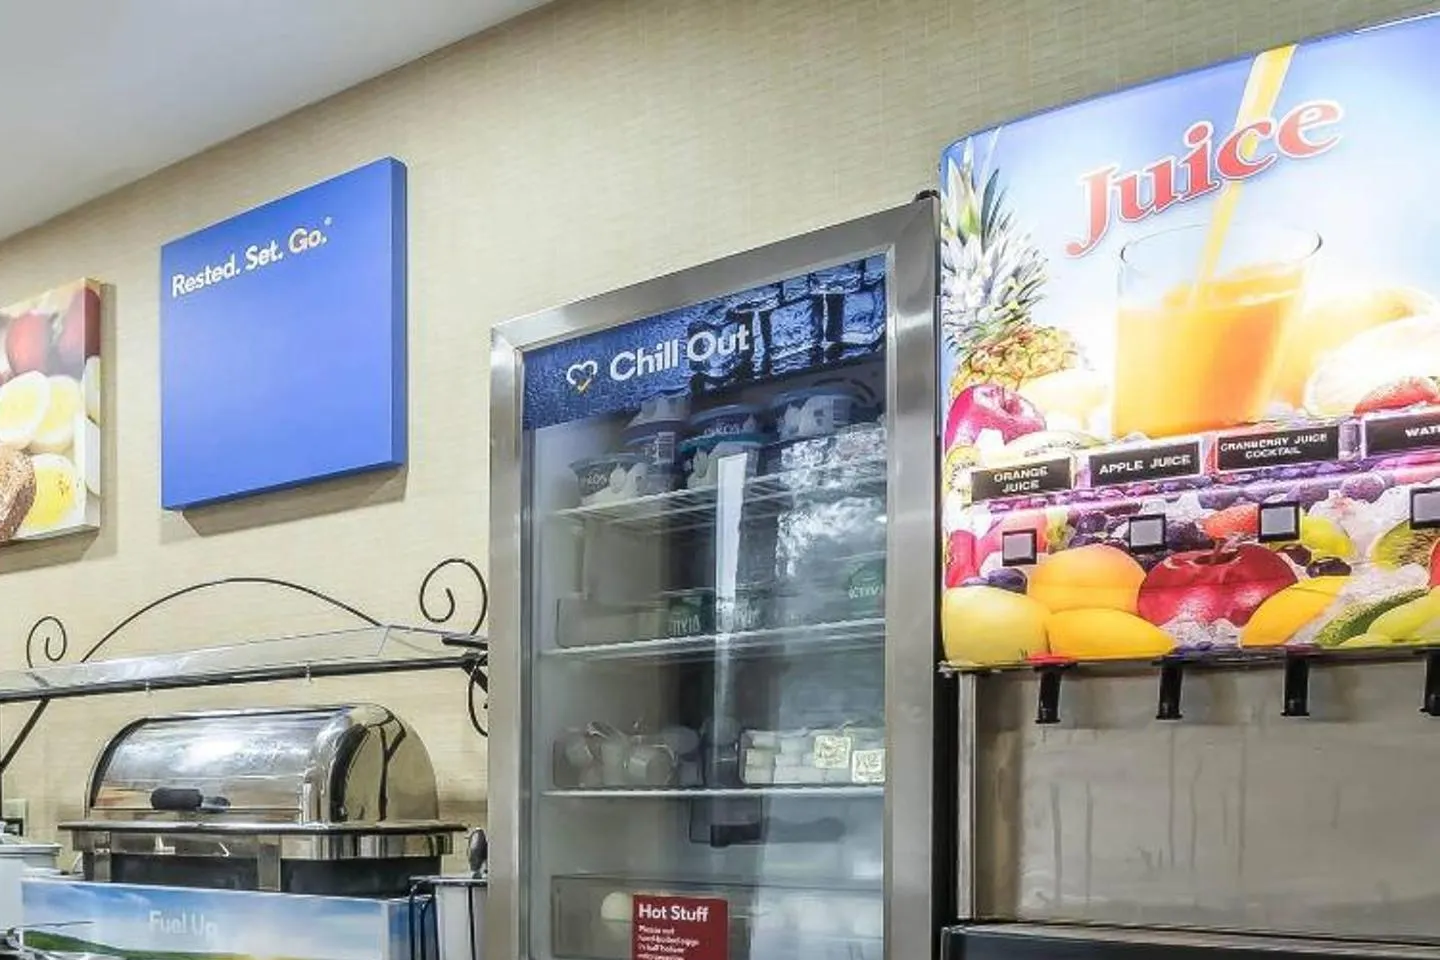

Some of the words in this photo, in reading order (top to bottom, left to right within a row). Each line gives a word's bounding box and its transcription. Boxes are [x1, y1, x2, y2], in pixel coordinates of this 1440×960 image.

[1064, 100, 1343, 259] Juice
[171, 252, 241, 298] Rested.
[245, 239, 284, 271] Set.
[609, 338, 679, 381] Chill
[686, 323, 750, 362] Out
[1220, 436, 1290, 452] CRANBERRY
[1293, 432, 1328, 445] JUICE
[1244, 446, 1302, 460] COCKTAIL
[993, 465, 1049, 483] ORANGE
[1098, 459, 1144, 476] APPLE
[1149, 454, 1192, 470] JUICE
[1002, 479, 1040, 494] JUICE
[638, 903, 667, 920] Hot
[670, 905, 709, 922] Stuff
[149, 909, 187, 934] Fuel
[191, 911, 218, 942] Up
